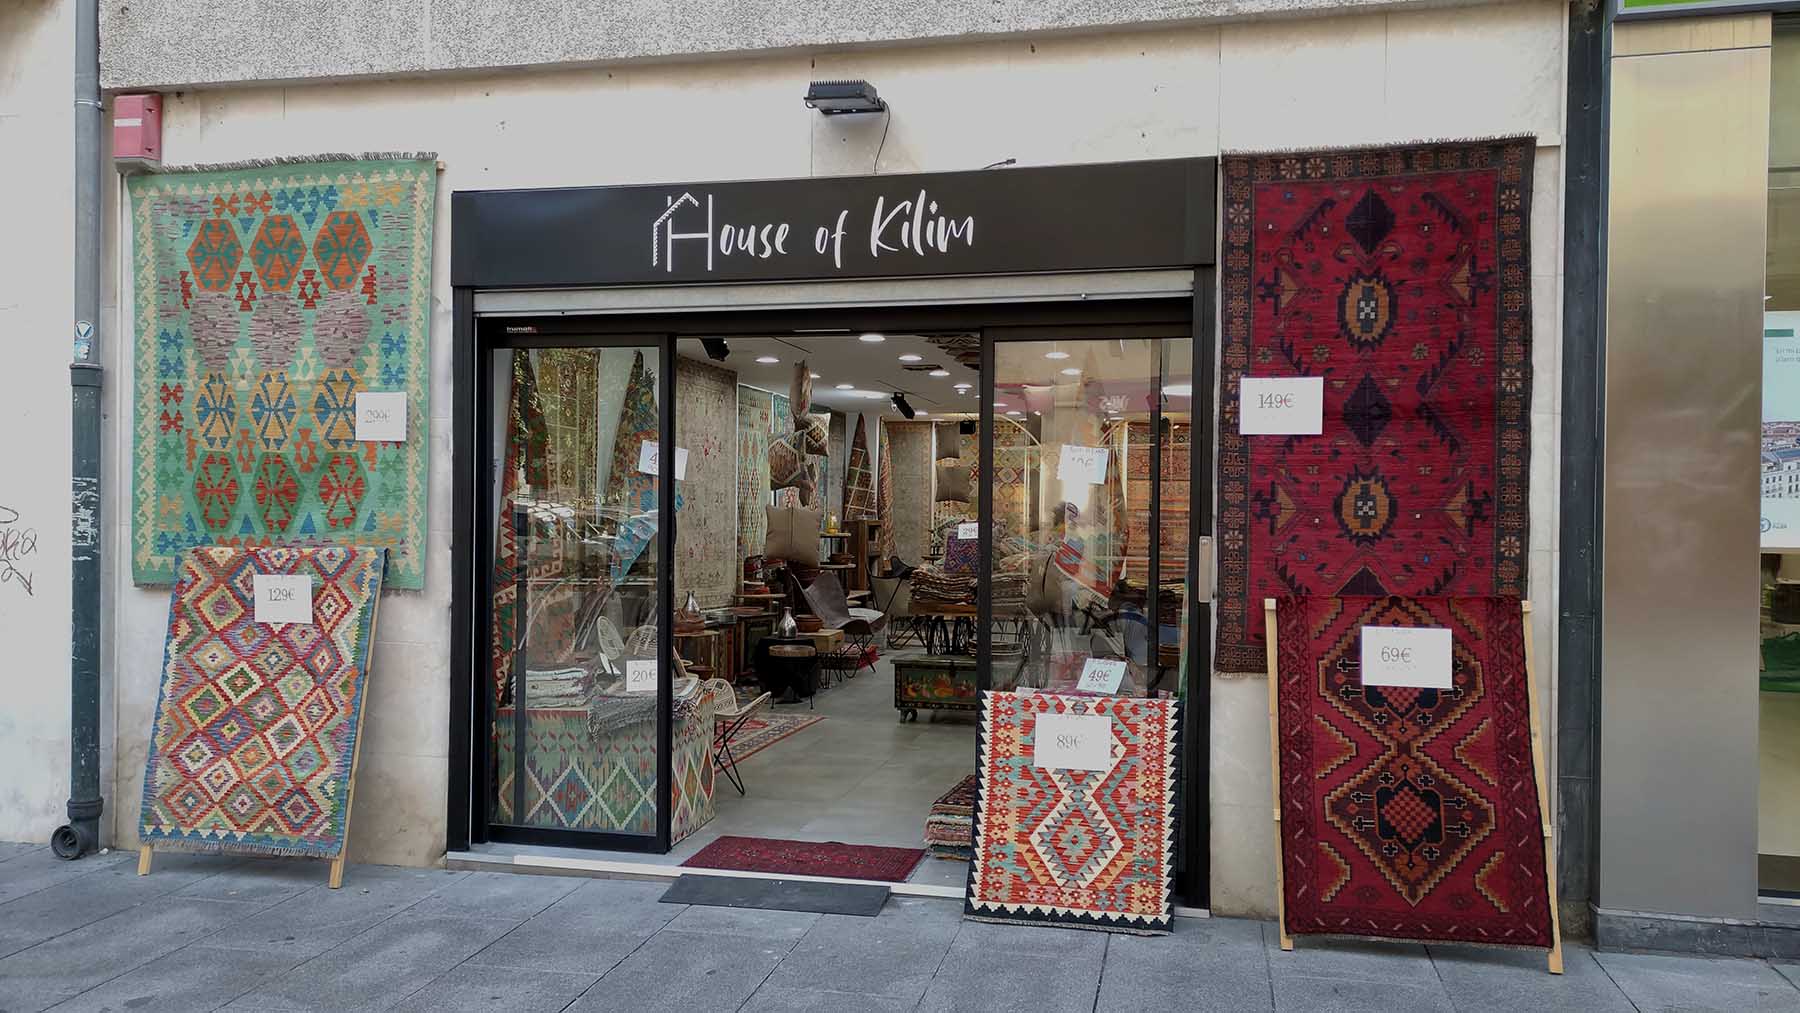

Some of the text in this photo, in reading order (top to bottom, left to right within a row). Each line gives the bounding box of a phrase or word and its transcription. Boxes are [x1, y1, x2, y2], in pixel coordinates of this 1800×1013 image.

[653, 189, 974, 272] House of Kilim
[1257, 391, 1296, 409] 149€
[267, 586, 296, 602] 129€
[1380, 646, 1413, 663] 69€
[631, 670, 657, 682] 20€
[1088, 669, 1112, 682] 49€
